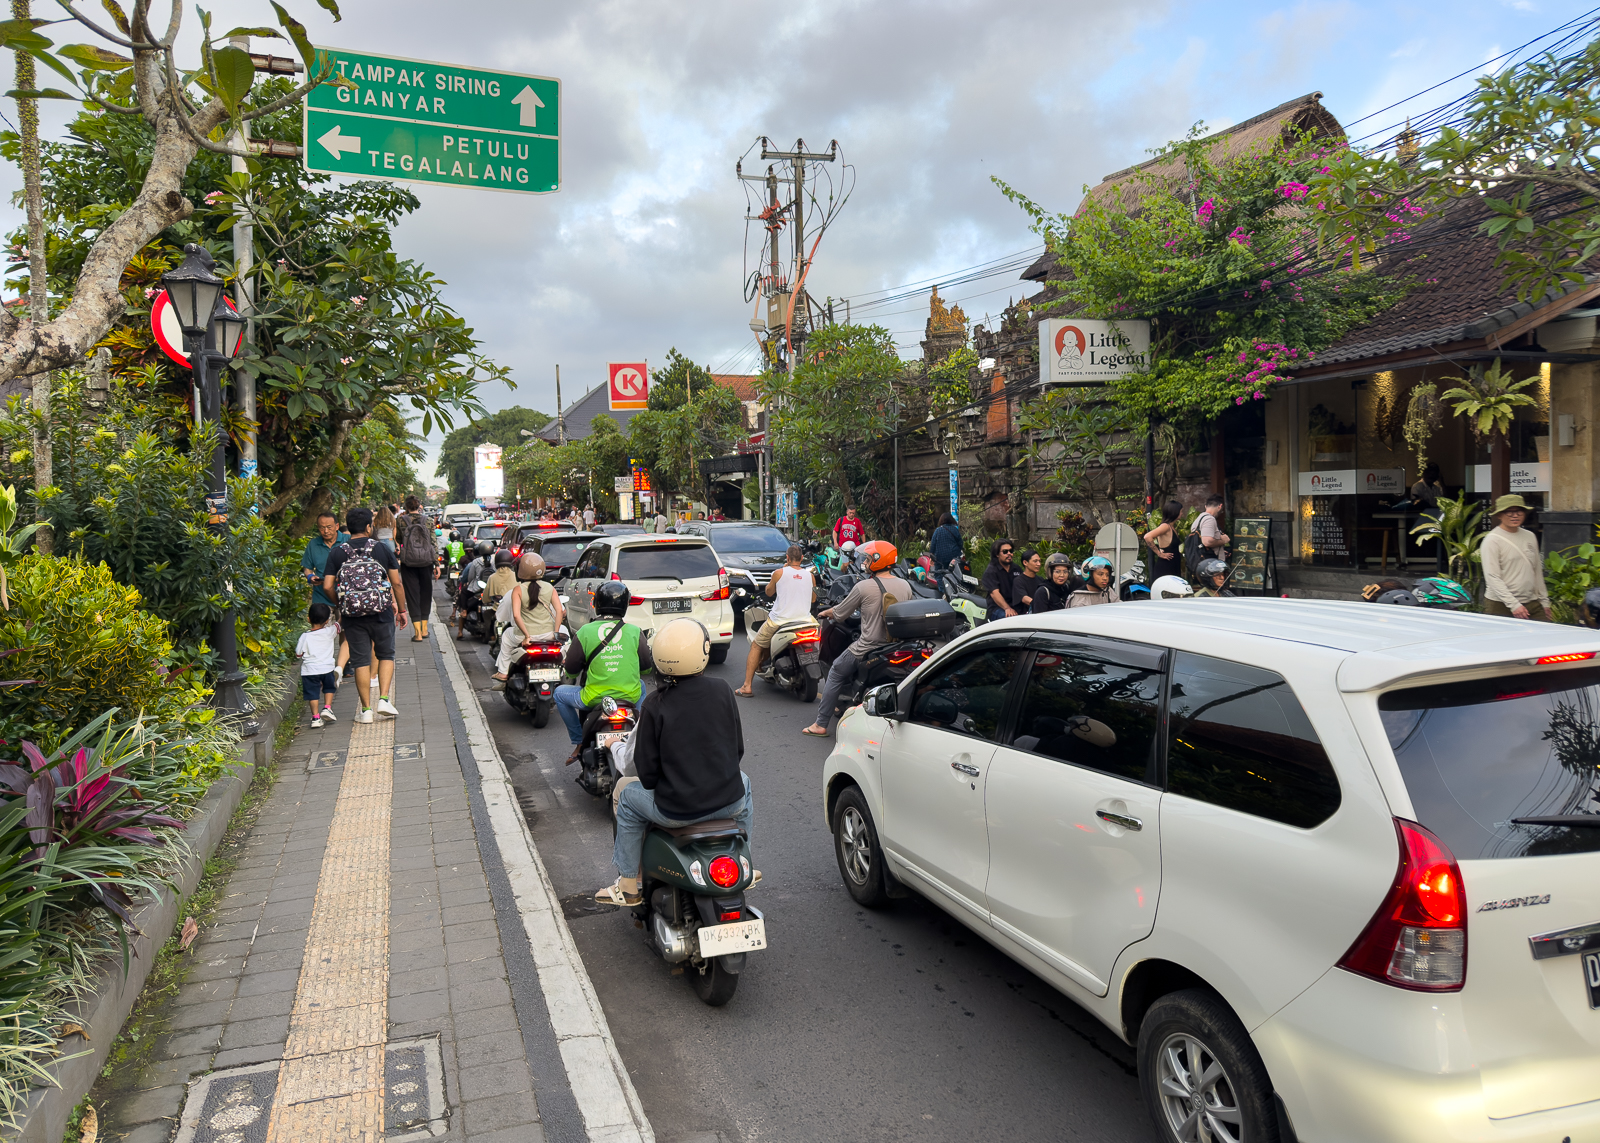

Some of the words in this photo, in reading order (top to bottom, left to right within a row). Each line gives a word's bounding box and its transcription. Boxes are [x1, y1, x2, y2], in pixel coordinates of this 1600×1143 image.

[336, 60, 426, 89] TAMPAK
[435, 72, 501, 97] SIRING
[336, 85, 447, 115] GIANYAR
[442, 135, 530, 160] PETULU
[368, 150, 529, 184] TEGALALANG
[1089, 333, 1131, 348] Little
[1089, 351, 1145, 370] Legend
[1509, 477, 1537, 485] egend
[600, 643, 623, 654] gojek
[1475, 893, 1551, 914] AVANZA
